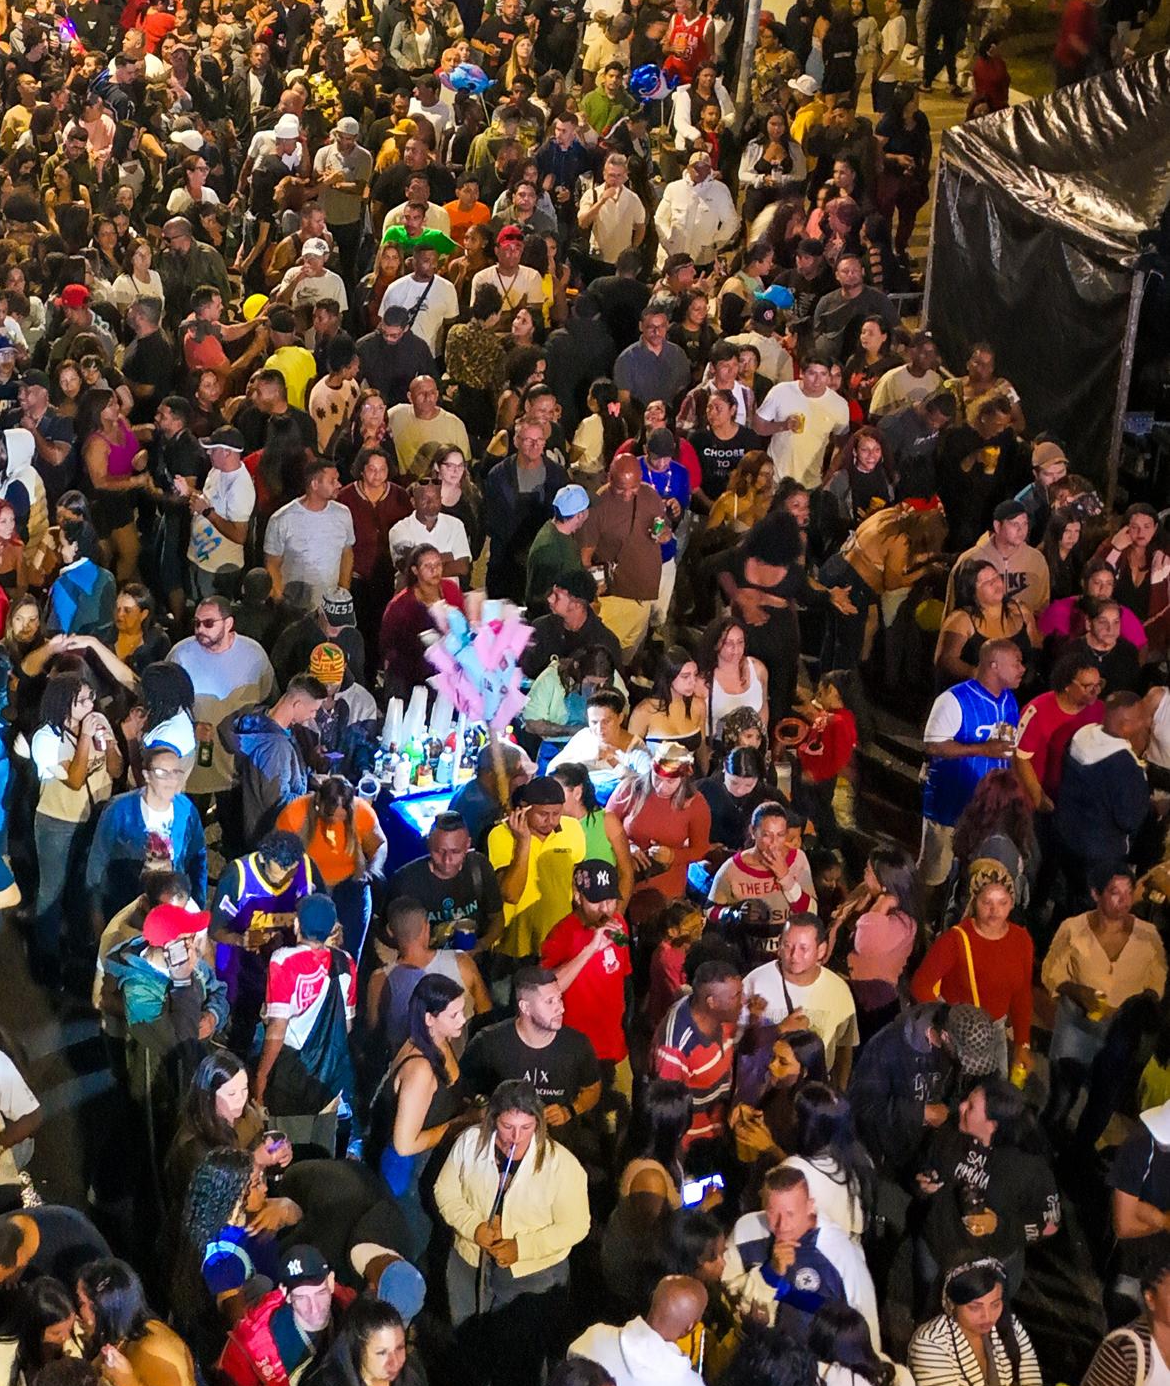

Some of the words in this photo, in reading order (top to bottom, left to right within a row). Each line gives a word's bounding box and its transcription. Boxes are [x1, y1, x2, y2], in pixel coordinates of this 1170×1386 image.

[717, 460, 730, 468] TO
[738, 883, 761, 896] THE
[764, 881, 781, 894] EA
